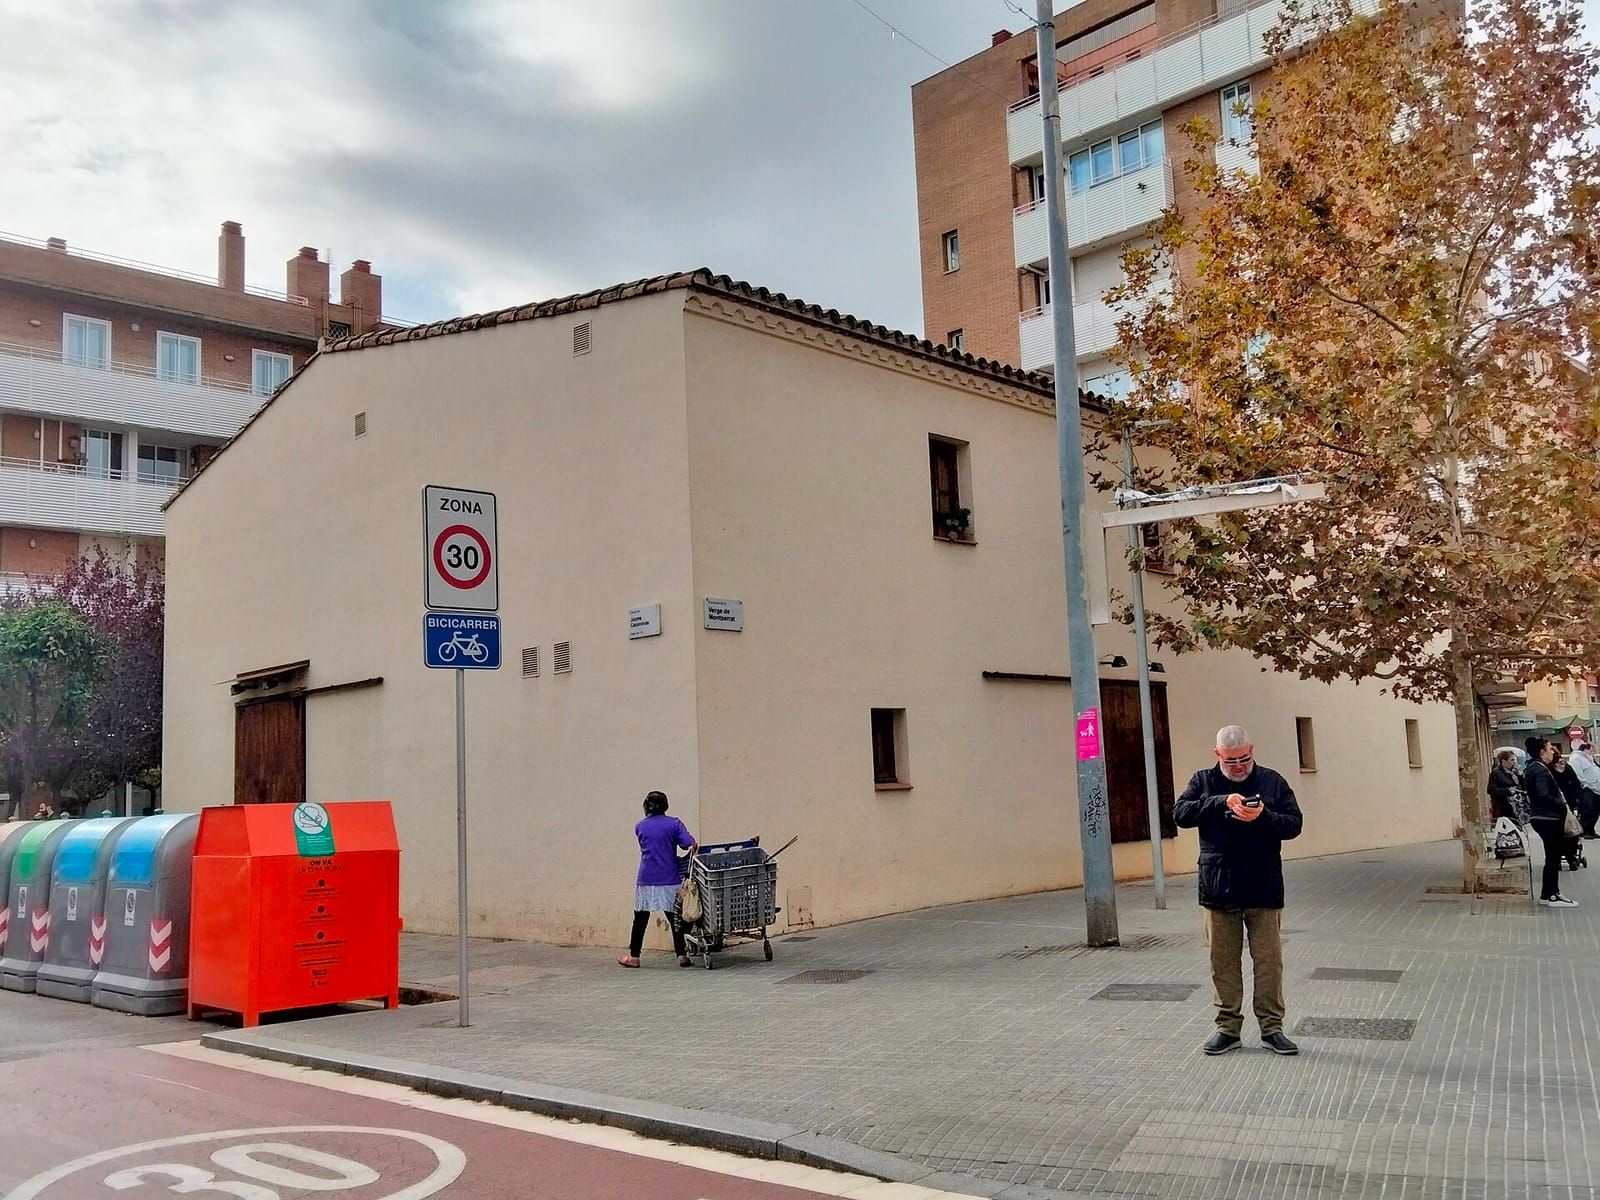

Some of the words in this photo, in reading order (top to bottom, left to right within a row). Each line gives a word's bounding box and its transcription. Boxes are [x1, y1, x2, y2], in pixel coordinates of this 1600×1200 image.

[440, 498, 483, 515] ZONA
[446, 544, 479, 570] 30
[708, 606, 723, 615] Verge
[428, 617, 497, 630] BICICARRER
[708, 614, 736, 622] Montserrat
